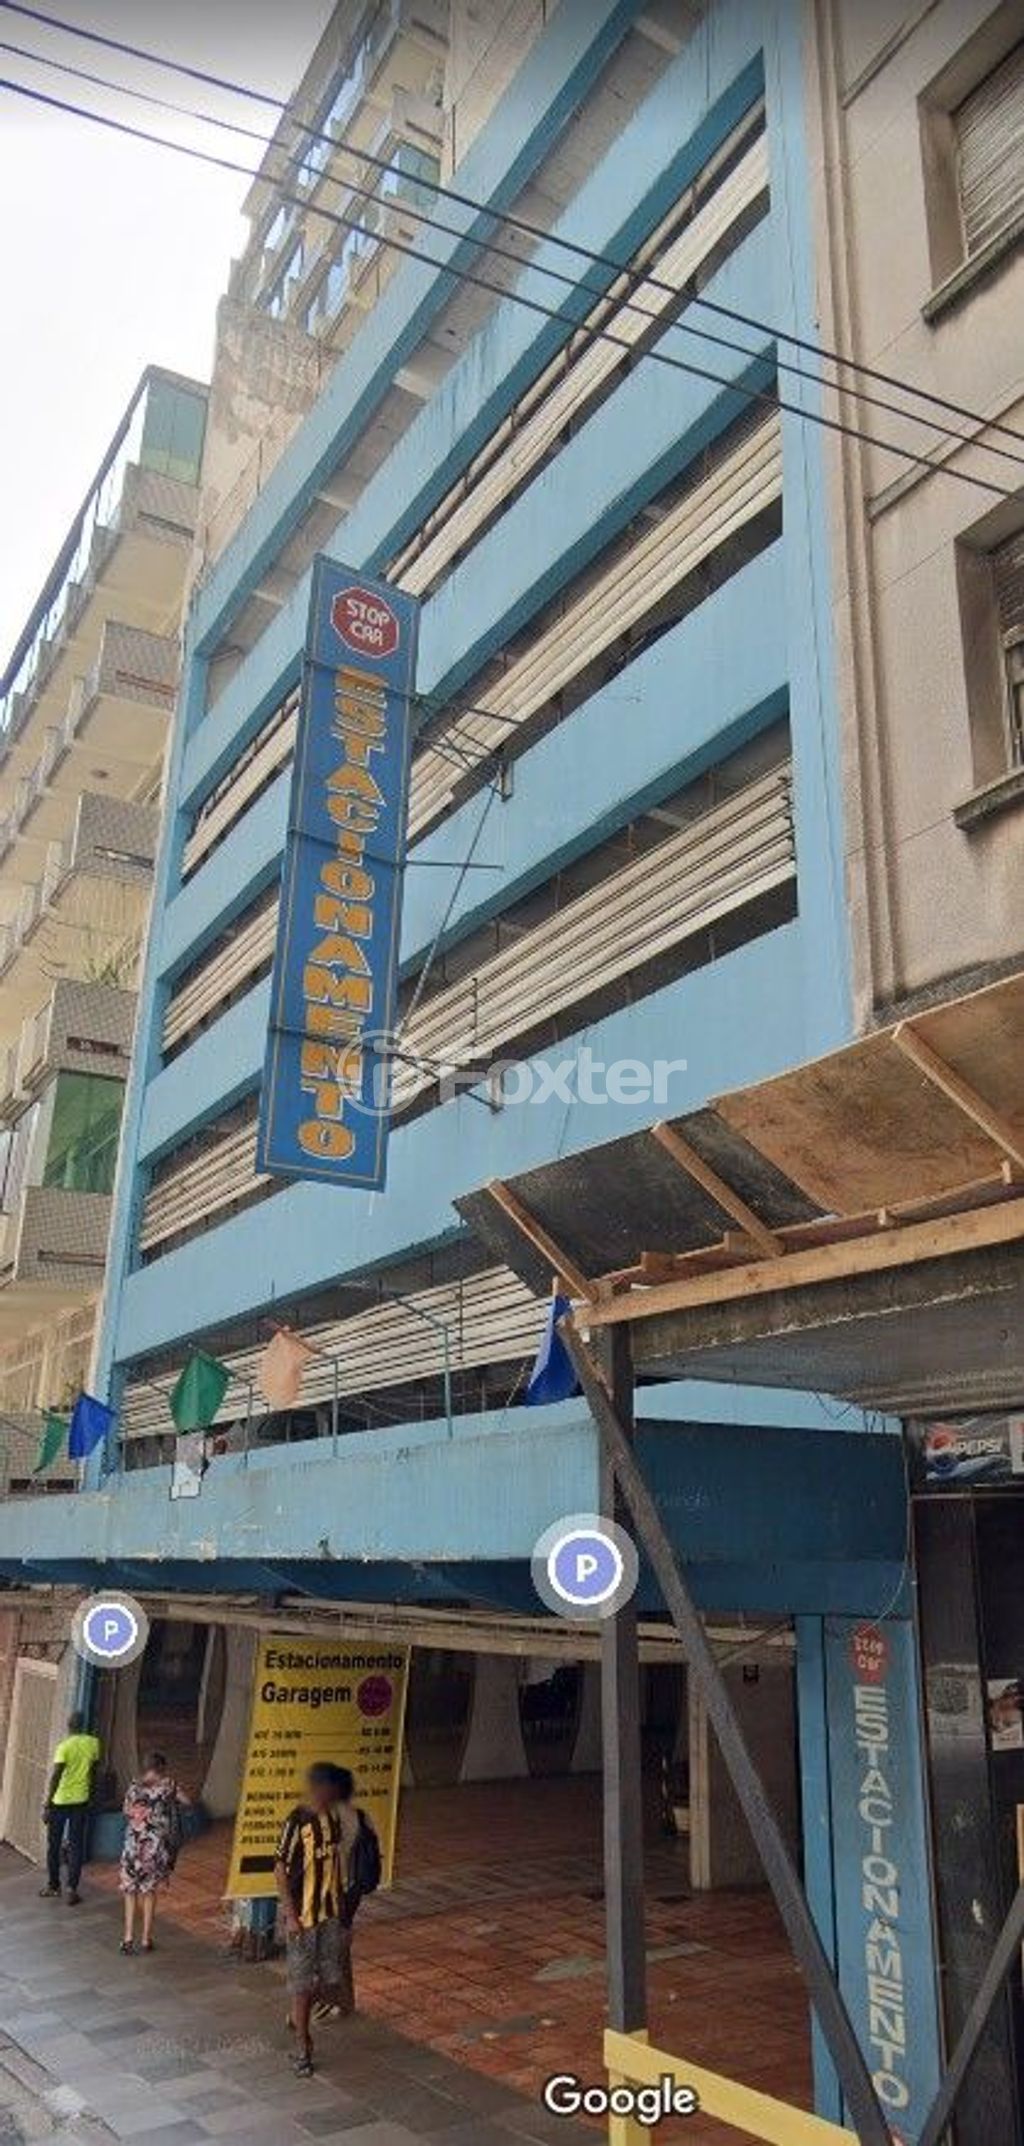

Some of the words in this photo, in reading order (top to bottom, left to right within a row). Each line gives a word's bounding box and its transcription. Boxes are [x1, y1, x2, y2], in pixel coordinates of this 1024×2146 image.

[347, 599, 390, 627] STOP
[350, 620, 383, 647] CAR
[297, 666, 389, 1160] ESTACIONAMENTO
[955, 1438, 1003, 1455] PEPSI
[264, 1649, 403, 1671] Estacionamento
[260, 1681, 352, 1709] Garagem
[852, 1684, 909, 2109] ESTACIONAMENTO
